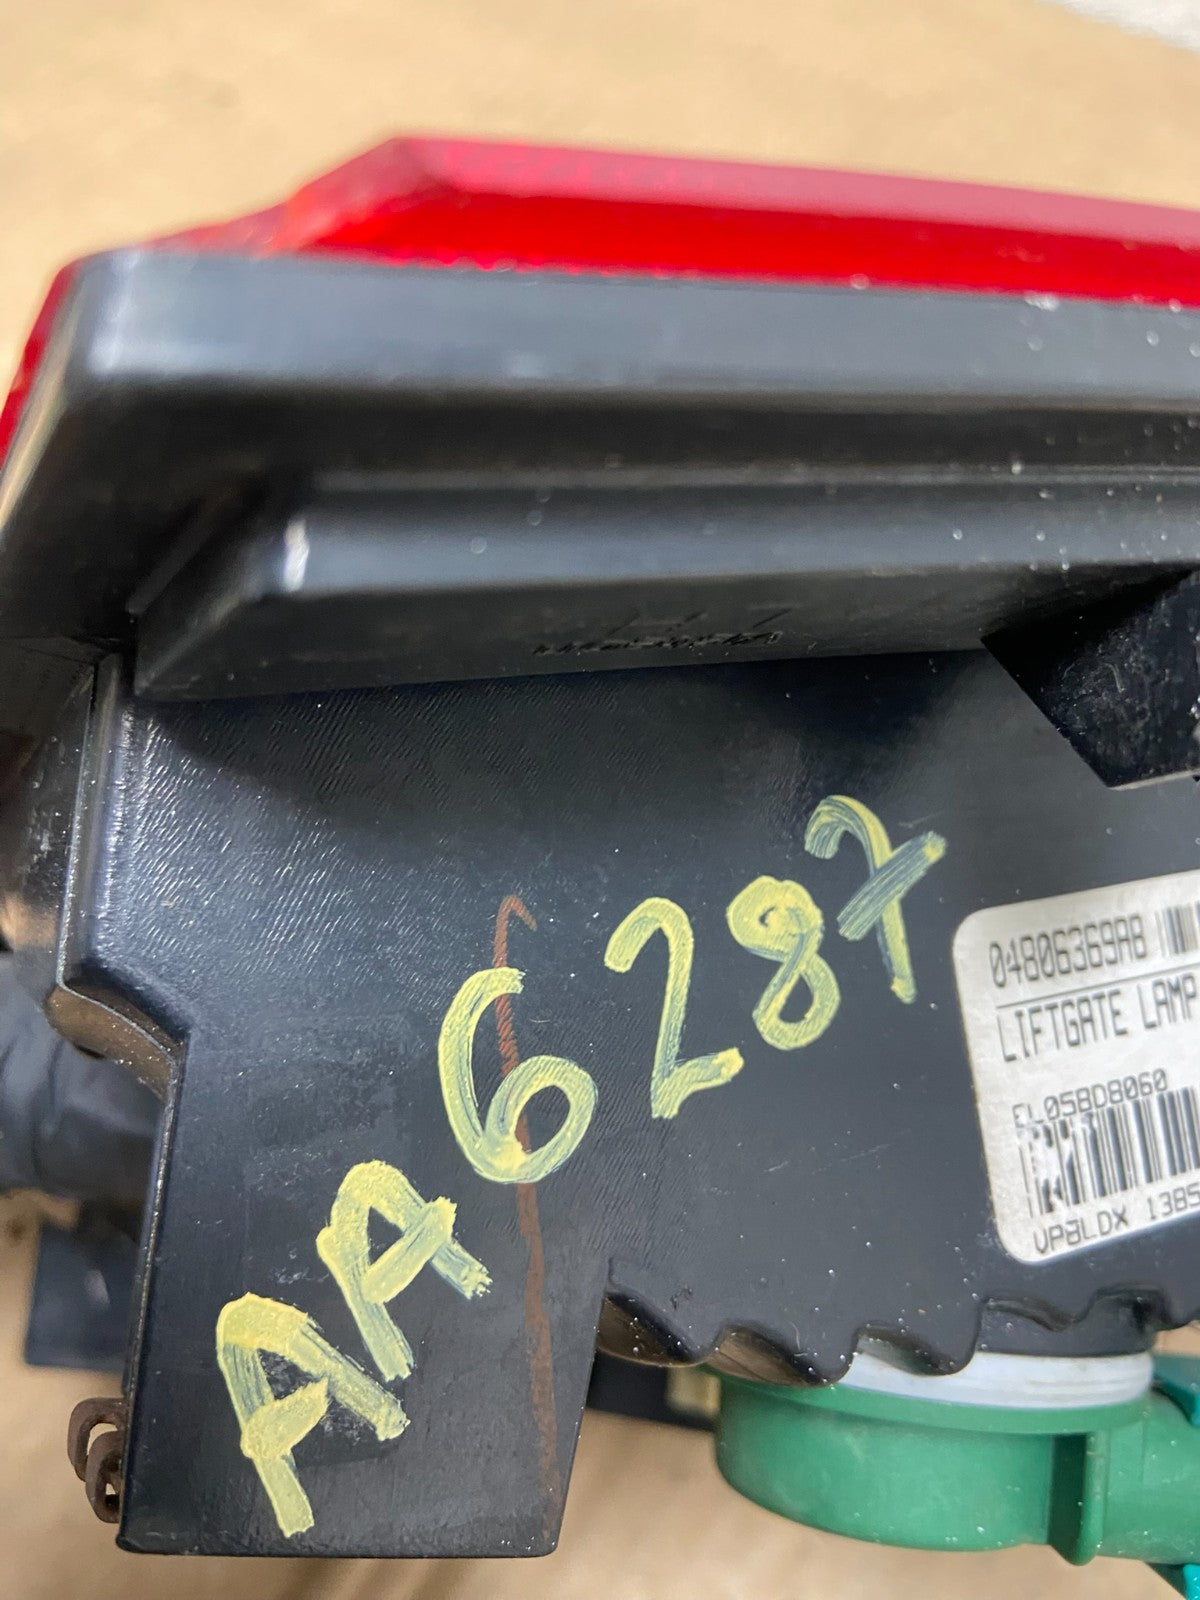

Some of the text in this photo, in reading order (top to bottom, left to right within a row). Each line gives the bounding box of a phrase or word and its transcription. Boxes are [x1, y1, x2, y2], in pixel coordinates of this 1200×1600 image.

[989, 913, 1147, 988] 04806369AB
[997, 973, 1198, 1062] LIFTGATE LAMP
